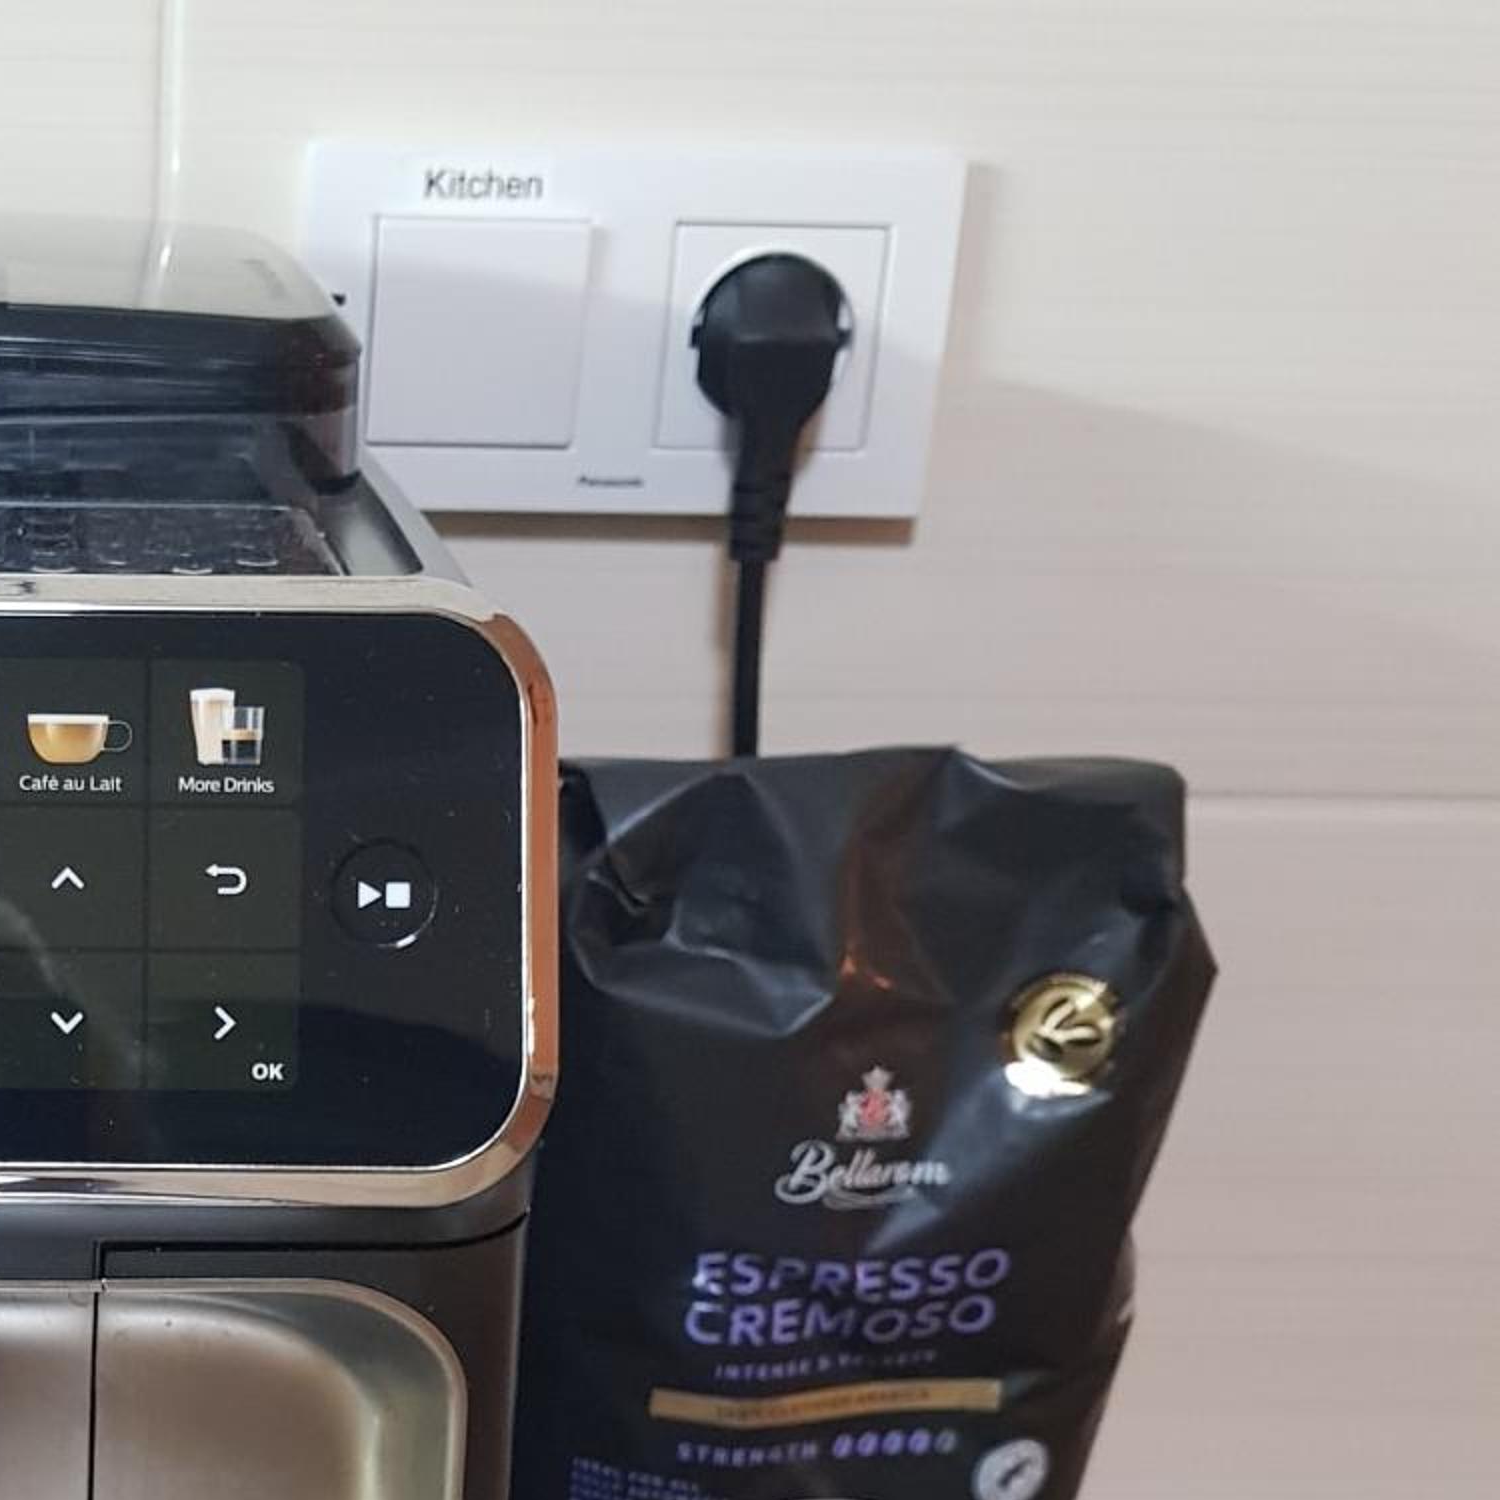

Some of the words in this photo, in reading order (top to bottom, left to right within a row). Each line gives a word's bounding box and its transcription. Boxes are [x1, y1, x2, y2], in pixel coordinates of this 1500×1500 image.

[422, 167, 544, 201] Kitchen
[20, 775, 58, 790] Café
[63, 779, 84, 790] au
[90, 776, 121, 791] Lait
[179, 777, 220, 792] More
[224, 777, 274, 792] Drinks
[252, 1063, 283, 1080] OK
[694, 1248, 1011, 1302] ESPRESSO
[685, 1296, 997, 1346] CREMOSO
